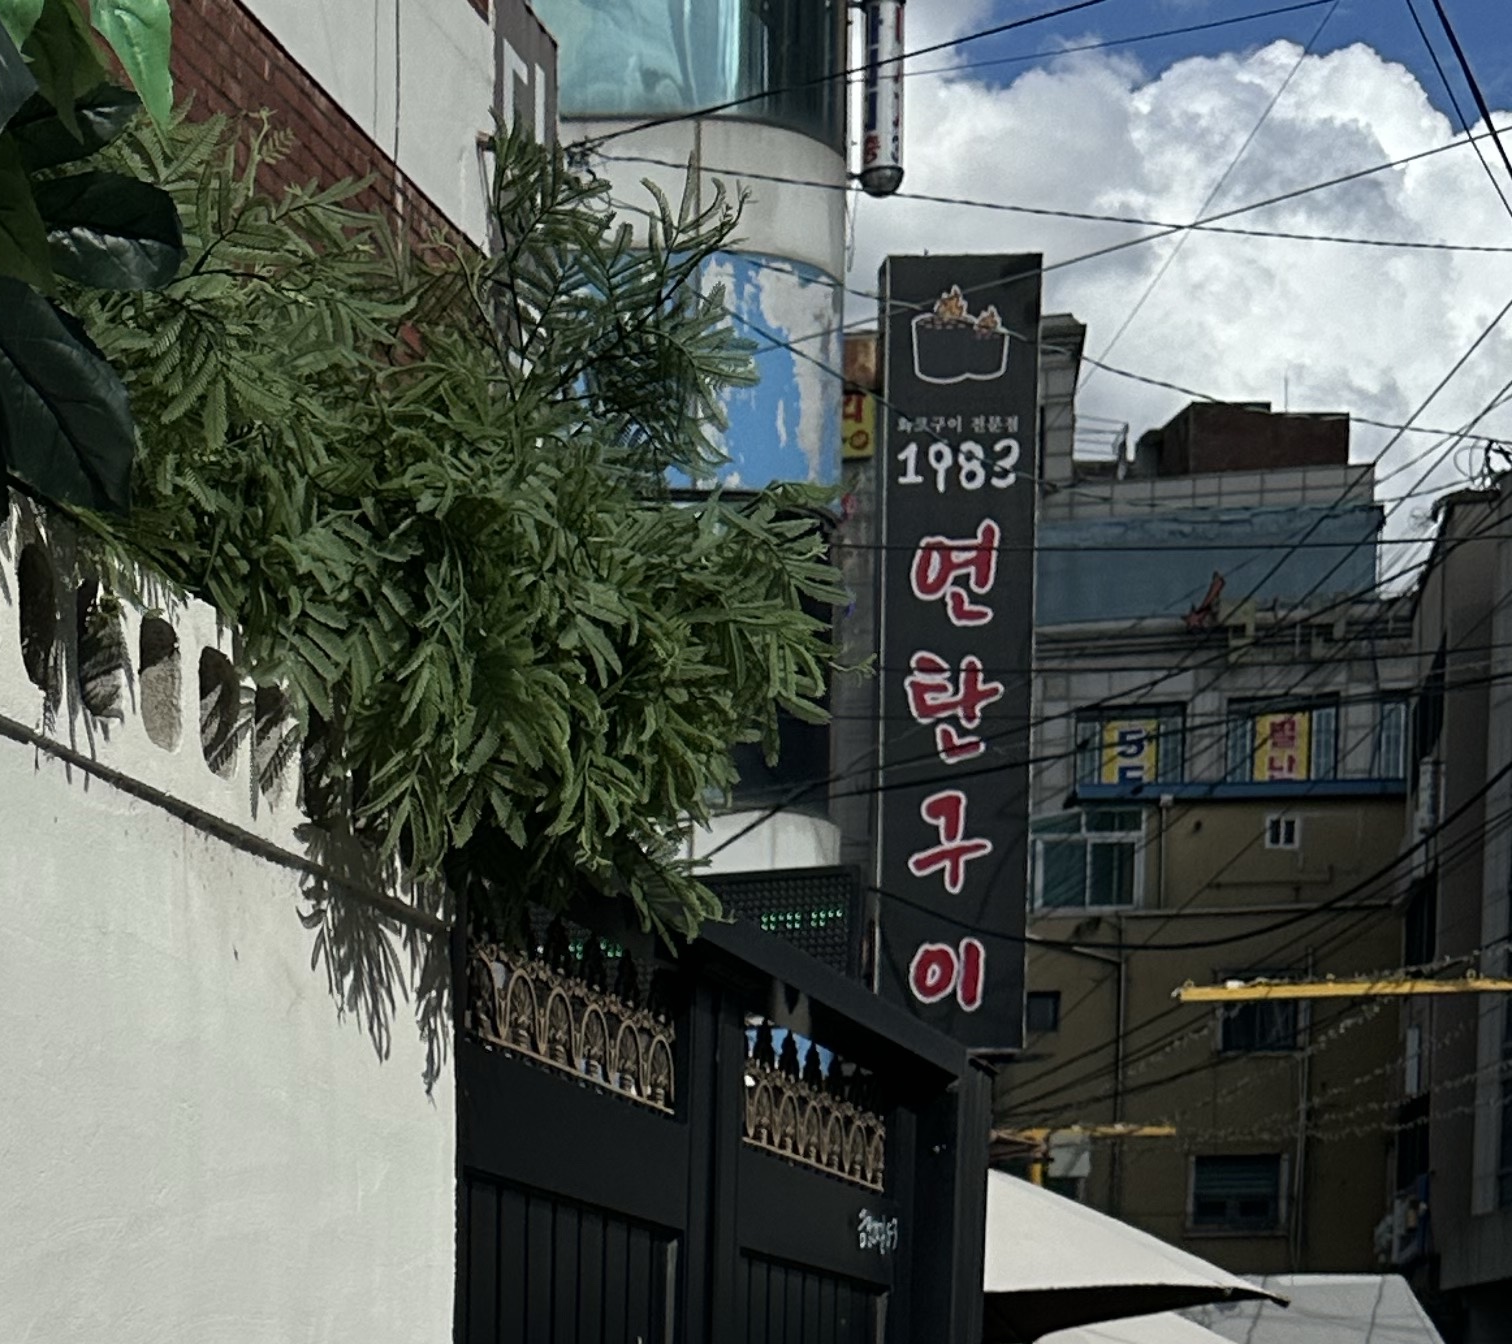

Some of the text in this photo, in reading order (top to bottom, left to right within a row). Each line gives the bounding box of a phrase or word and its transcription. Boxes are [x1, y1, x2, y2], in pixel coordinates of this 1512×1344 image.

[971, 414, 1019, 433] 전문점
[897, 438, 1020, 493] 1983
[904, 518, 1004, 1011] 연탄구이
